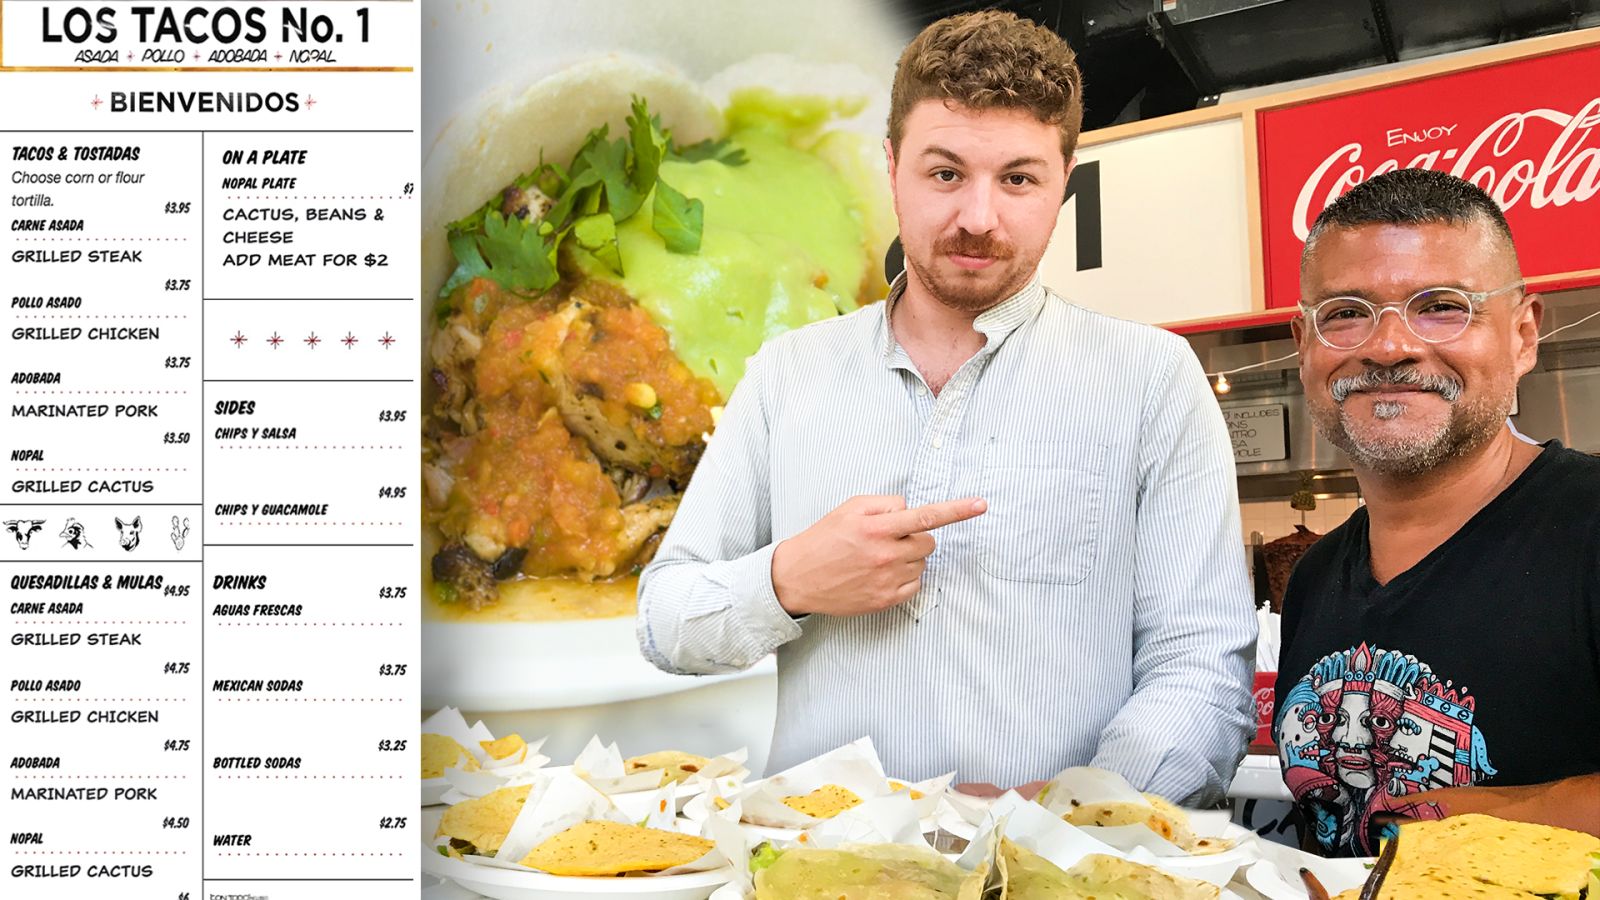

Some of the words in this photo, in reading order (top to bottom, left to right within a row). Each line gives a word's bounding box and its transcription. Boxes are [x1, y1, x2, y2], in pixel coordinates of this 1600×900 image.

[43, 7, 117, 43] LOS
[131, 7, 266, 43] TACOS
[282, 7, 343, 43] No.
[357, 8, 368, 42] 1
[75, 50, 118, 63] ASADA
[142, 49, 185, 63] POLLO
[208, 49, 267, 63] ADOBADA
[289, 49, 336, 63] NOPAL
[111, 92, 299, 112] BIENVENIDOS
[1386, 124, 1458, 147] ENJOY
[13, 146, 54, 161] TACOS
[58, 146, 67, 160] &
[74, 146, 140, 161] TOSTADAS
[223, 150, 243, 164] ON
[247, 150, 258, 164] A
[262, 150, 308, 164] PLATE
[12, 171, 61, 183] Choose
[65, 174, 94, 183] corn
[98, 174, 112, 183] or
[116, 171, 145, 183] flour
[222, 178, 257, 189] NOPAL
[262, 178, 297, 189] PLATE
[12, 194, 53, 206] tortilla.
[165, 202, 191, 213] $3.95
[223, 208, 298, 222] CACTUS,
[306, 208, 366, 220] BEANS
[374, 208, 384, 221] &
[1062, 160, 1103, 272] 1
[11, 220, 46, 231] CARNE
[48, 220, 84, 231] ASADA
[223, 231, 293, 243] CHEESE
[12, 250, 82, 262] GRILLED
[88, 250, 142, 262] STEAK
[223, 254, 261, 266] ADD
[268, 254, 316, 266] MEAT
[323, 254, 357, 266] FOR
[364, 253, 388, 267] $2
[165, 279, 191, 290] $3.75
[11, 297, 43, 308] POLLO
[46, 297, 81, 308] ASADO
[12, 328, 82, 340] GRILLED
[88, 328, 159, 340] CHICKEN
[165, 356, 191, 368] $3.75
[11, 372, 60, 384] ADOBADA
[12, 405, 109, 417] MARINATED
[116, 405, 158, 417] PORK
[214, 401, 255, 415] SIDES
[1233, 409, 1280, 419] INCLUDES
[379, 410, 406, 422] $3.95
[164, 432, 190, 443] $3.50
[215, 428, 248, 439] CHIPS
[252, 428, 259, 439] Y
[261, 428, 296, 439] SALSA
[1232, 440, 1248, 449] SA
[11, 450, 43, 461] NOPAL
[12, 480, 82, 492] GRILLED
[88, 481, 153, 492] CACTUS
[379, 487, 407, 498] $4.95
[215, 504, 248, 515] CHIPS
[252, 504, 259, 515] Y
[262, 504, 328, 515] GUACAMOLE
[11, 575, 99, 589] QUESADILLAS
[102, 575, 112, 589] &
[117, 575, 163, 589] MULAS
[213, 575, 267, 589] DRINKS
[164, 585, 190, 596] $4.95
[379, 587, 407, 598] $3.75
[11, 603, 45, 614] CARNE
[48, 603, 83, 614] ASADA
[213, 604, 250, 616] AGUAS
[253, 604, 302, 616] FRESCAS
[11, 633, 81, 645] GRILLED
[87, 633, 141, 645] STEAK
[164, 662, 190, 673] $4.75
[379, 664, 407, 675] $3.75
[11, 680, 42, 691] POLLO
[45, 680, 81, 691] ASADO
[213, 680, 263, 691] MEXICAN
[266, 680, 303, 691] SODAS
[11, 711, 81, 723] GRILLED
[87, 710, 158, 723] CHICKEN
[164, 740, 190, 751] $4.75
[378, 740, 407, 751] $3.25
[10, 757, 60, 768] ADOBADA
[213, 757, 261, 769] BOTTLED
[264, 757, 301, 769] SODAS
[11, 788, 108, 800] MARINATED
[115, 788, 157, 800] PORK
[163, 817, 189, 828] $4.50
[380, 817, 407, 829] $2.75
[10, 833, 43, 844] NOPAL
[213, 835, 252, 846] WATER
[11, 865, 81, 877] GRILLED
[87, 865, 153, 877] CACTUS
